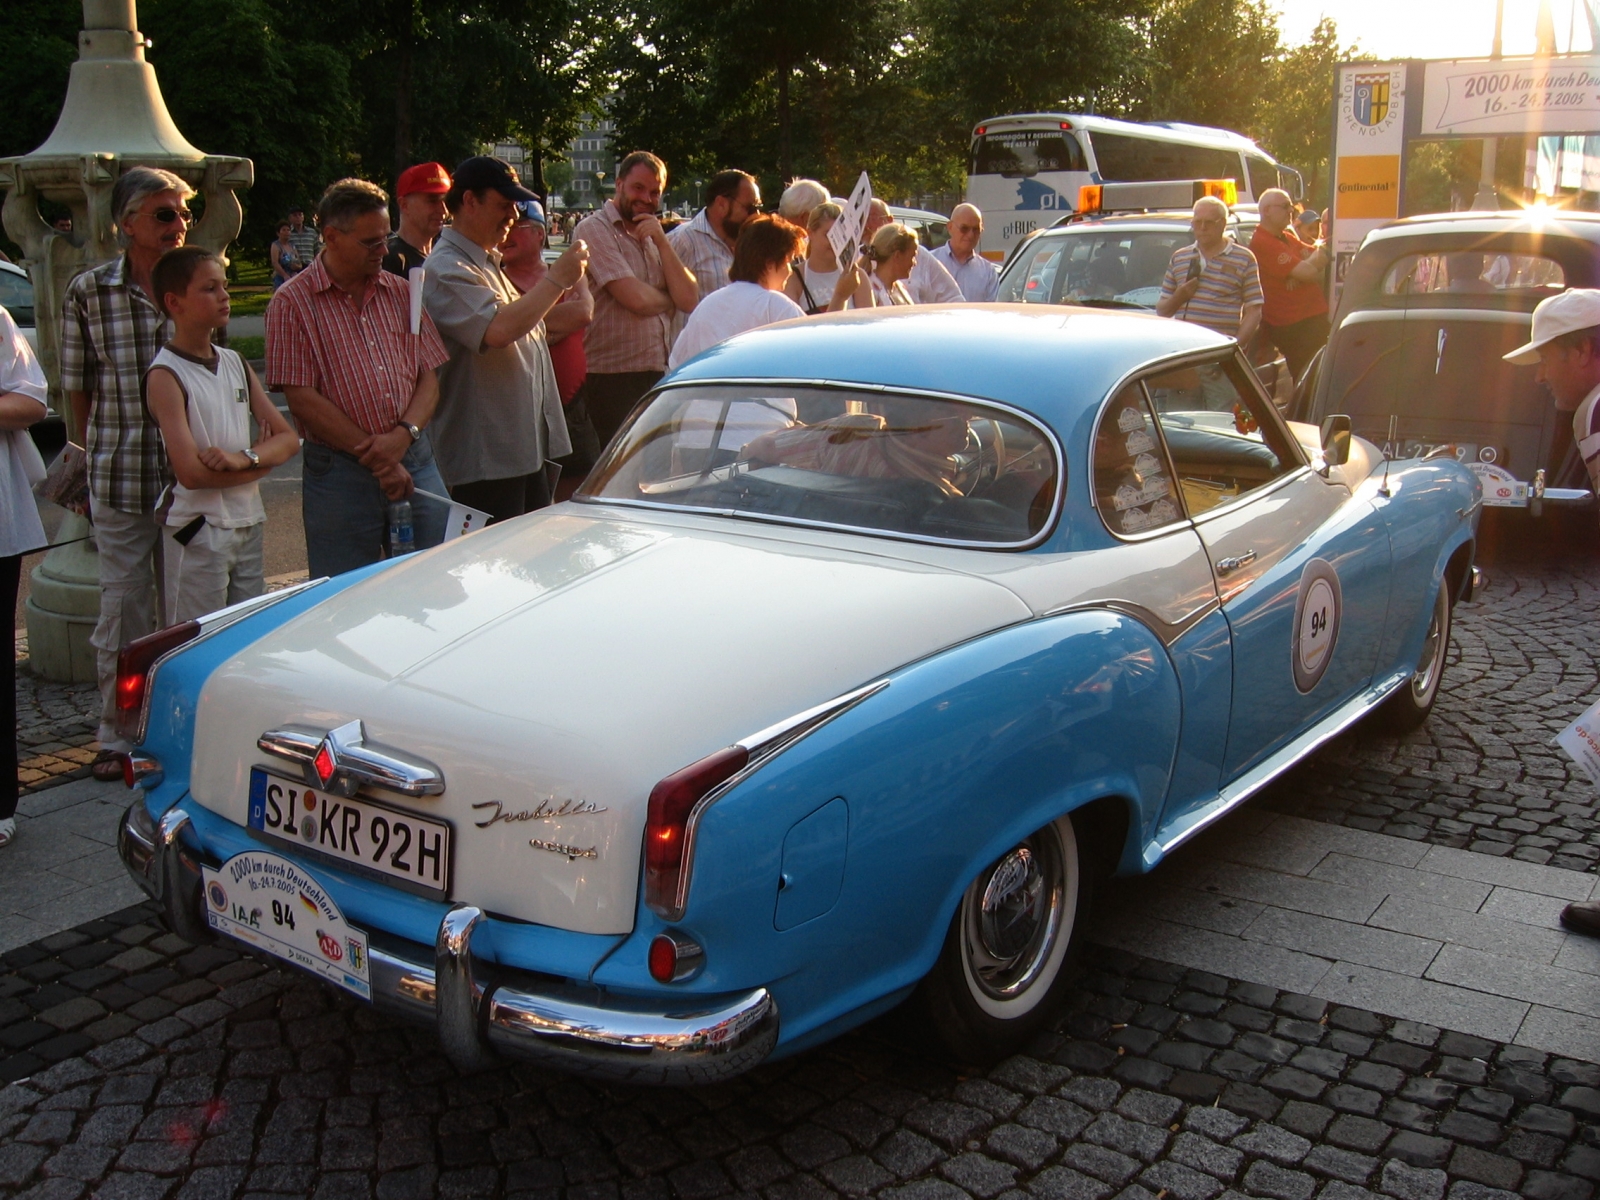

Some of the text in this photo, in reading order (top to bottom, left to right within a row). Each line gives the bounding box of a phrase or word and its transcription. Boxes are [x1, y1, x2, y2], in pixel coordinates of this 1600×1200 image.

[1464, 73, 1510, 99] 2000
[1512, 73, 1534, 91] km
[1536, 71, 1575, 89] durch
[1338, 182, 1389, 194] Continental
[1311, 606, 1327, 638] 94
[254, 805, 261, 818] D
[265, 784, 441, 881] SI KR 92H
[230, 857, 338, 922] 2000 km durch Deutschland
[232, 902, 260, 929] IAA
[272, 899, 295, 931] 94
